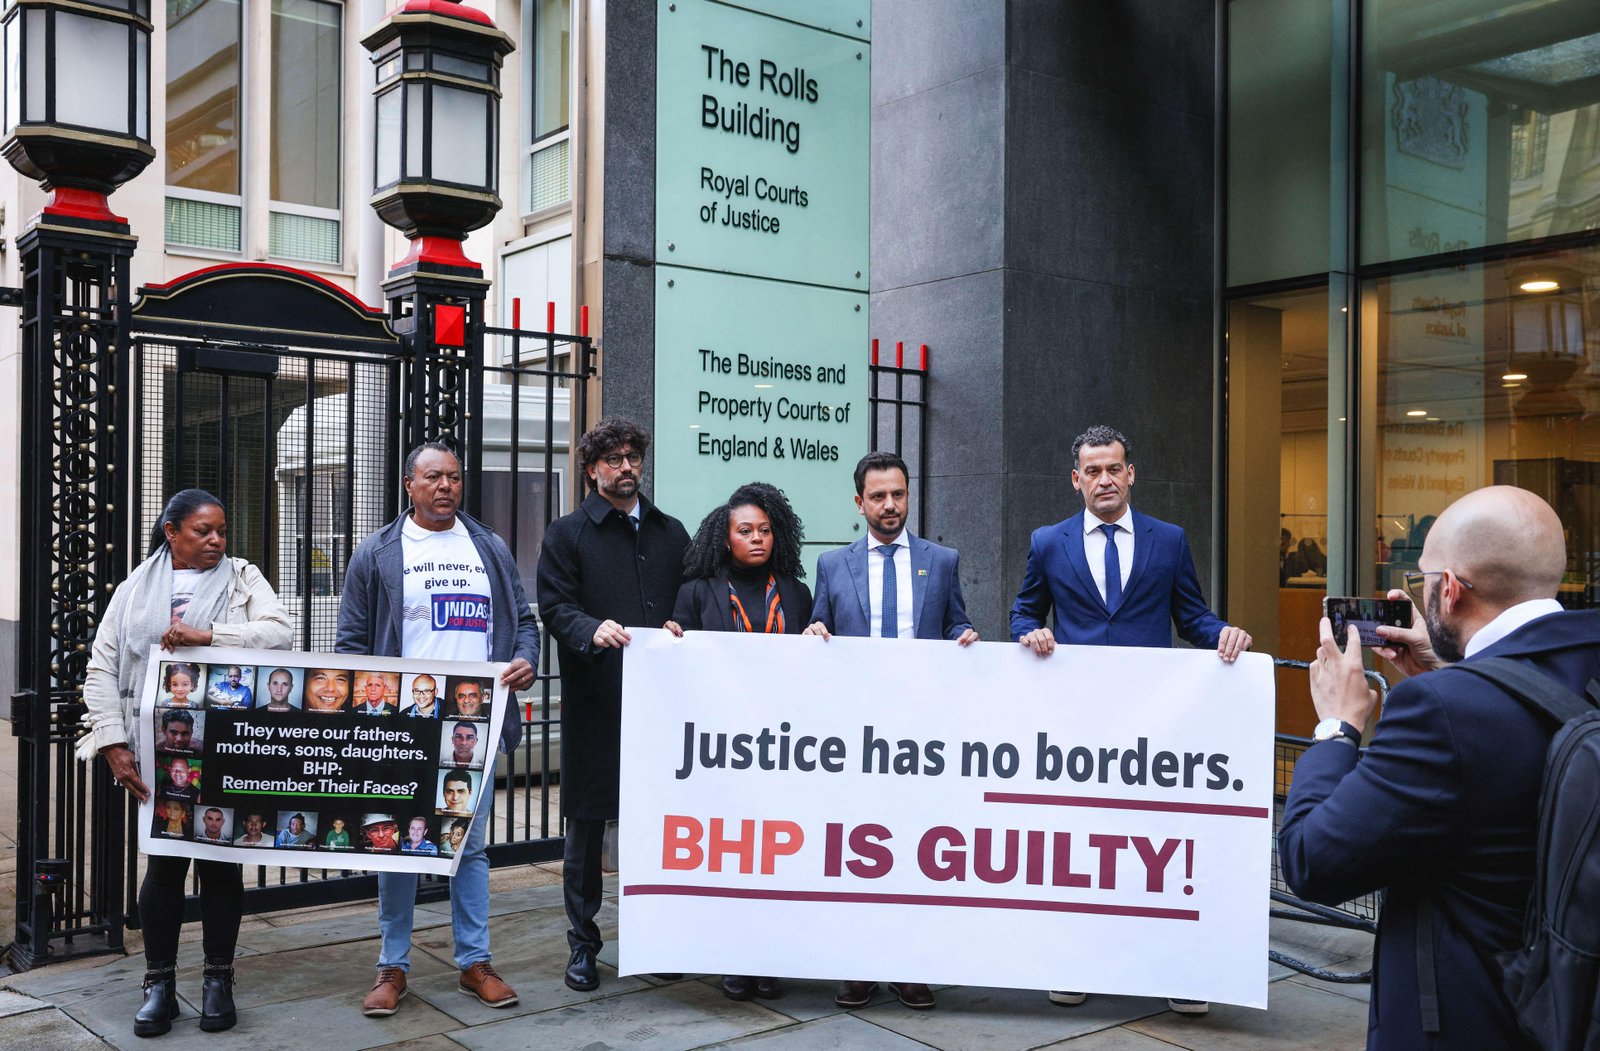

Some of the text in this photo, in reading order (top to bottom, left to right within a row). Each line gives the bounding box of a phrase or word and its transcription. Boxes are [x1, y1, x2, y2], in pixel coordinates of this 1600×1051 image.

[701, 45, 818, 104] The Rolls
[701, 95, 801, 153] Building
[700, 167, 809, 207] Royal Courts
[700, 202, 780, 234] of Justice
[699, 349, 846, 384] The Business and
[699, 391, 850, 423] Property Courts of
[699, 432, 839, 461] England & Wales
[413, 562, 434, 573] will
[438, 563, 473, 573] never,
[425, 578, 471, 589] give up.
[234, 722, 414, 744] They were our fathers,
[216, 740, 428, 762] mothers, sons, daughters.
[676, 722, 1244, 791] Justice has no borders.
[303, 761, 342, 776] BHP:
[223, 775, 418, 796] Remember Their Faces?
[662, 815, 1195, 896] BHP IS GUILTY!
